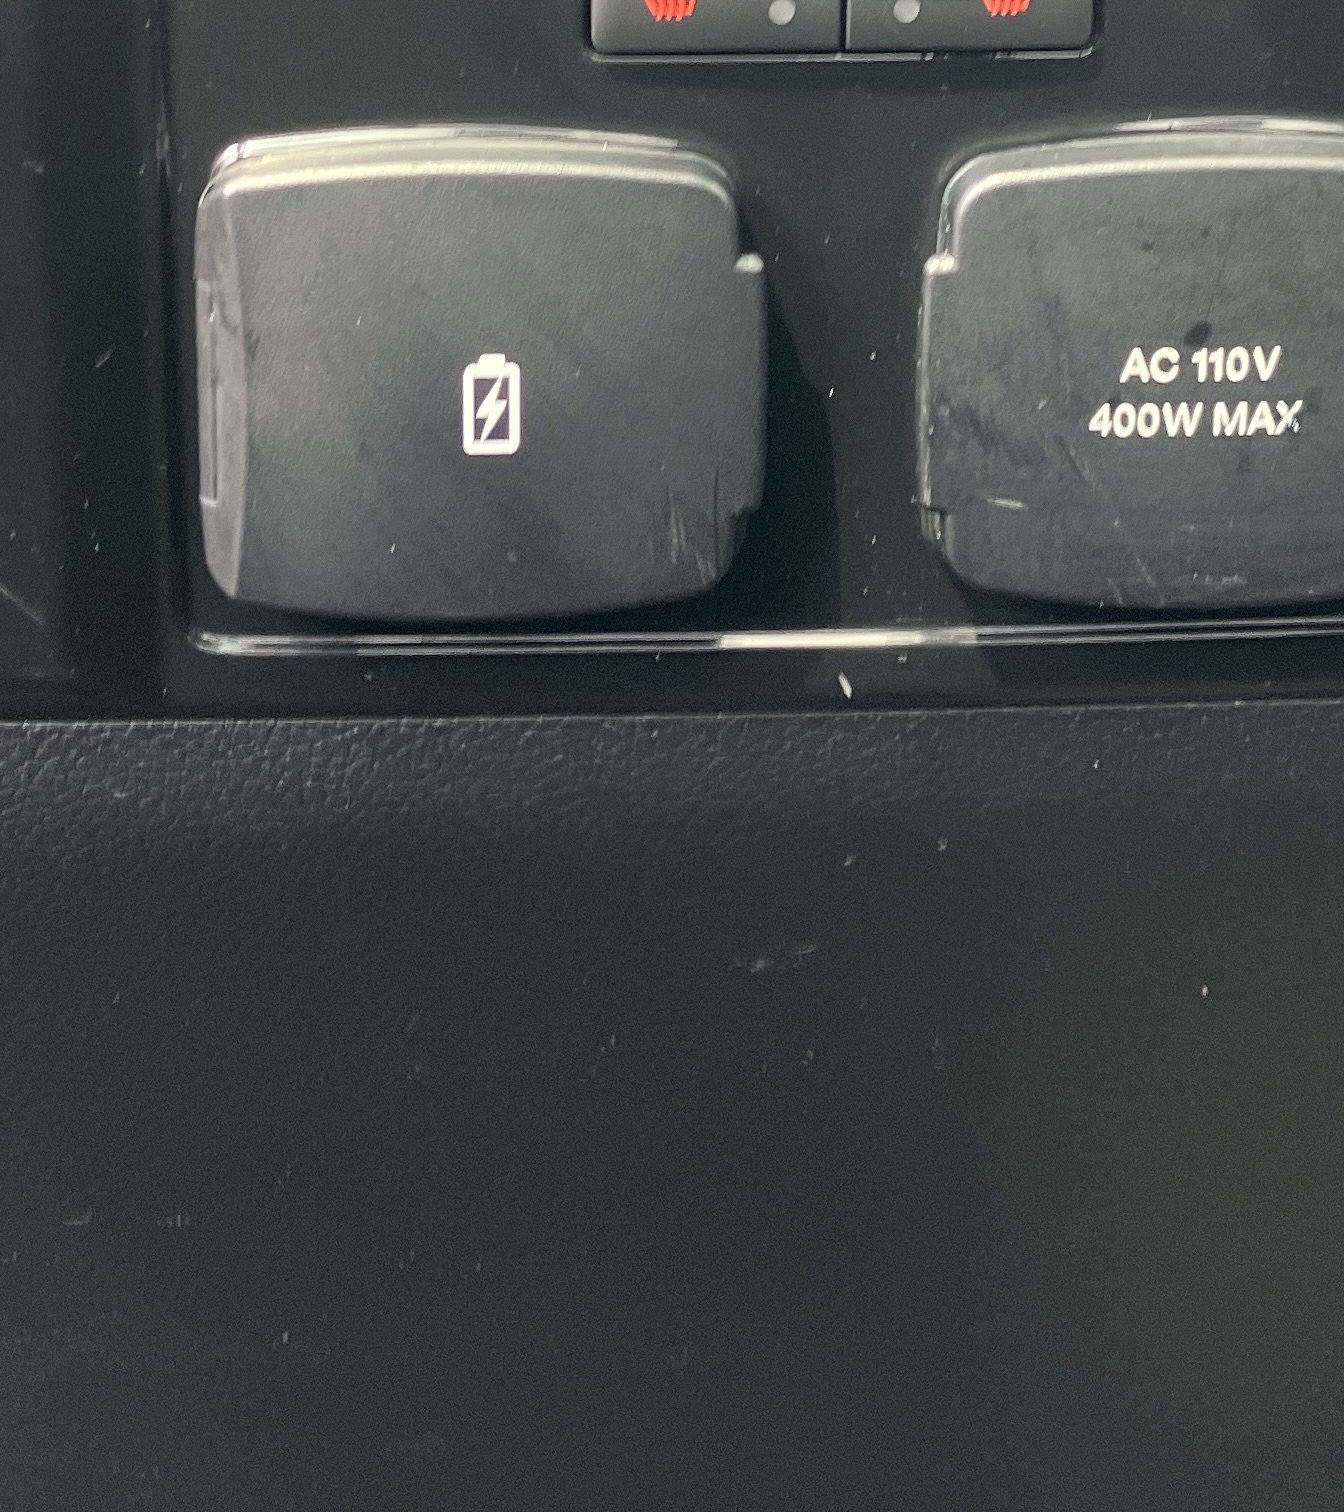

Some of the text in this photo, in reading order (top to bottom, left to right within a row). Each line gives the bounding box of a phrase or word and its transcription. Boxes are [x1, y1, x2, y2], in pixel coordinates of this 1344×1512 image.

[1119, 344, 1282, 384] AC 110V
[1088, 399, 1304, 439] 400W MAX
